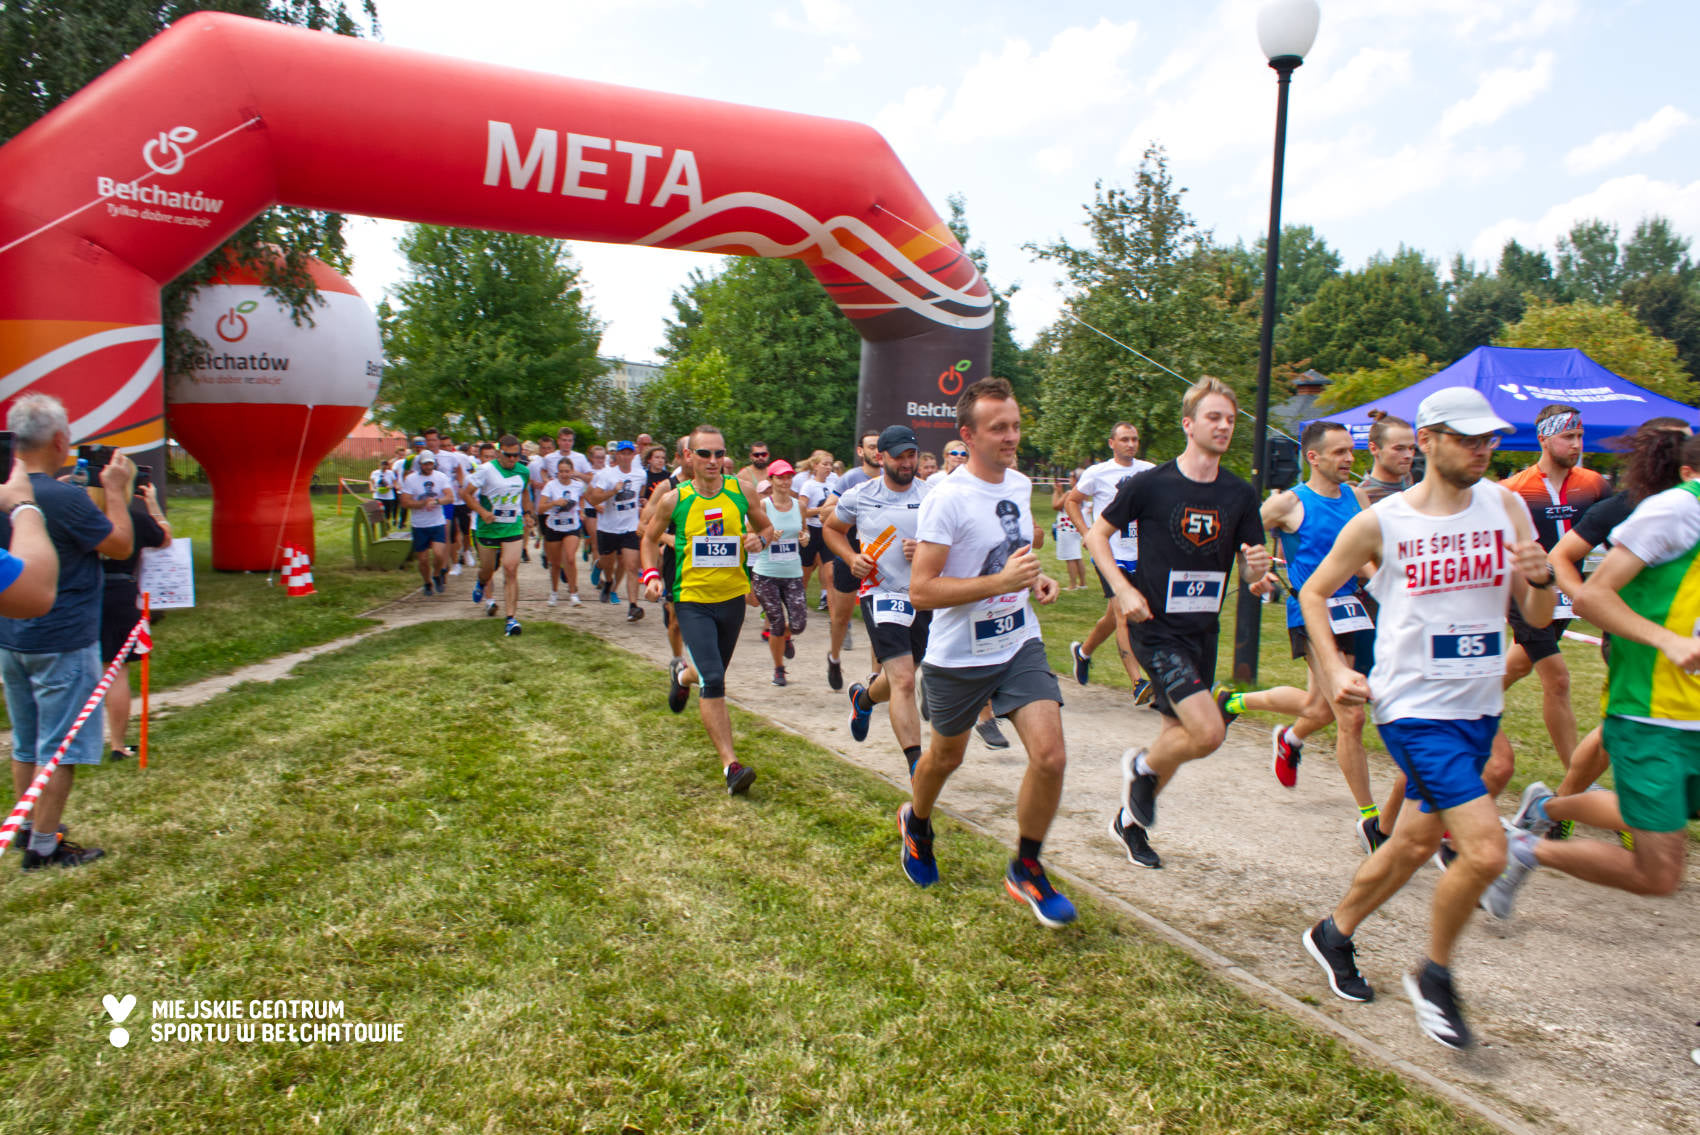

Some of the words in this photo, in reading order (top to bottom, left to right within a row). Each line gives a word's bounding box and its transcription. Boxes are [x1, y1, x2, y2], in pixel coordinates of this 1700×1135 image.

[483, 120, 703, 211] META
[97, 176, 224, 213] Bełchatów
[106, 203, 139, 217] Tylko
[141, 208, 173, 223] dobre
[1545, 505, 1578, 514] ZTPL
[706, 543, 728, 556] 136
[779, 543, 791, 553] 114
[1398, 538, 1424, 560] NIE
[1430, 532, 1466, 556] ŚPIĘ
[1472, 530, 1492, 550] BO
[1186, 581, 1206, 597] 69
[890, 600, 905, 612] 28
[1344, 604, 1357, 617] 17
[994, 615, 1015, 635] 30
[1457, 635, 1487, 657] 85
